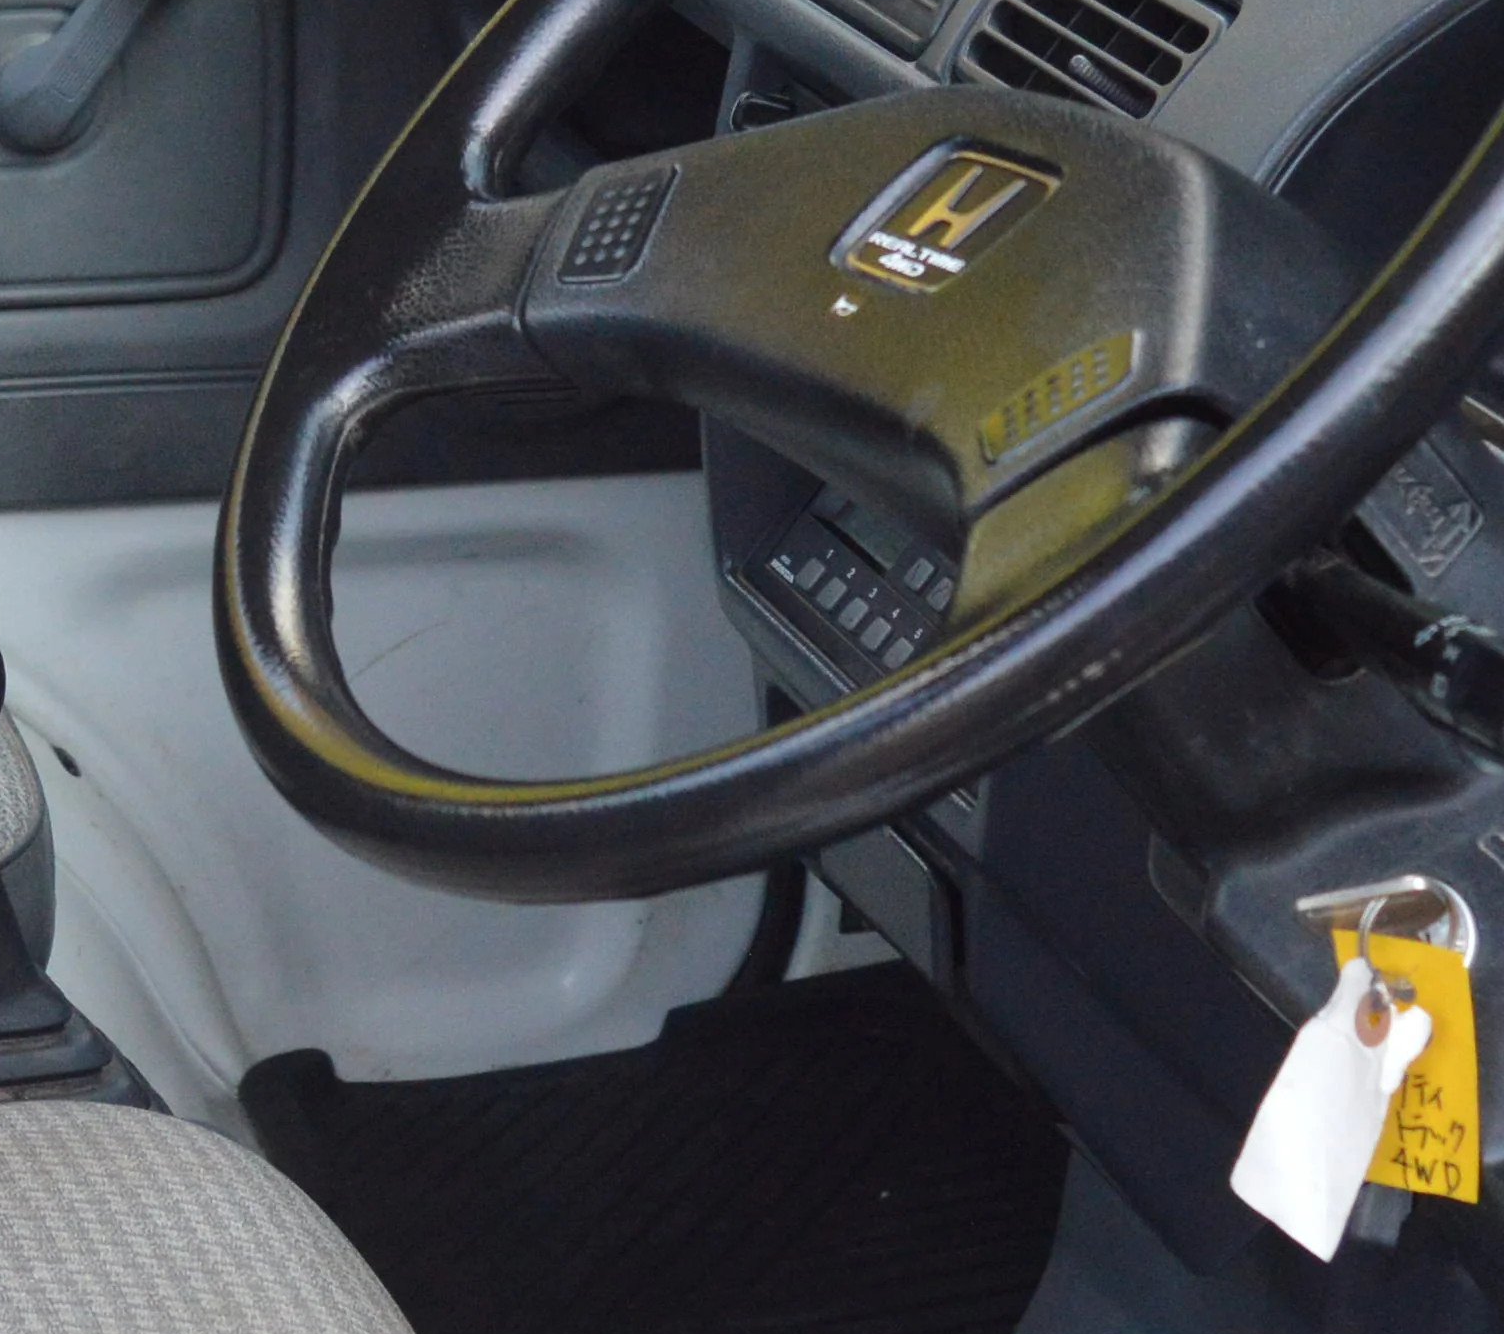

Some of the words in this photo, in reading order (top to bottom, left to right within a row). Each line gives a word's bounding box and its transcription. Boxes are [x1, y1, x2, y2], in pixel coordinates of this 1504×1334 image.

[826, 549, 834, 559] 1
[846, 568, 856, 579] 2
[868, 587, 878, 599] 3
[892, 608, 901, 618] 4
[1390, 1147, 1462, 1196] 4WD
